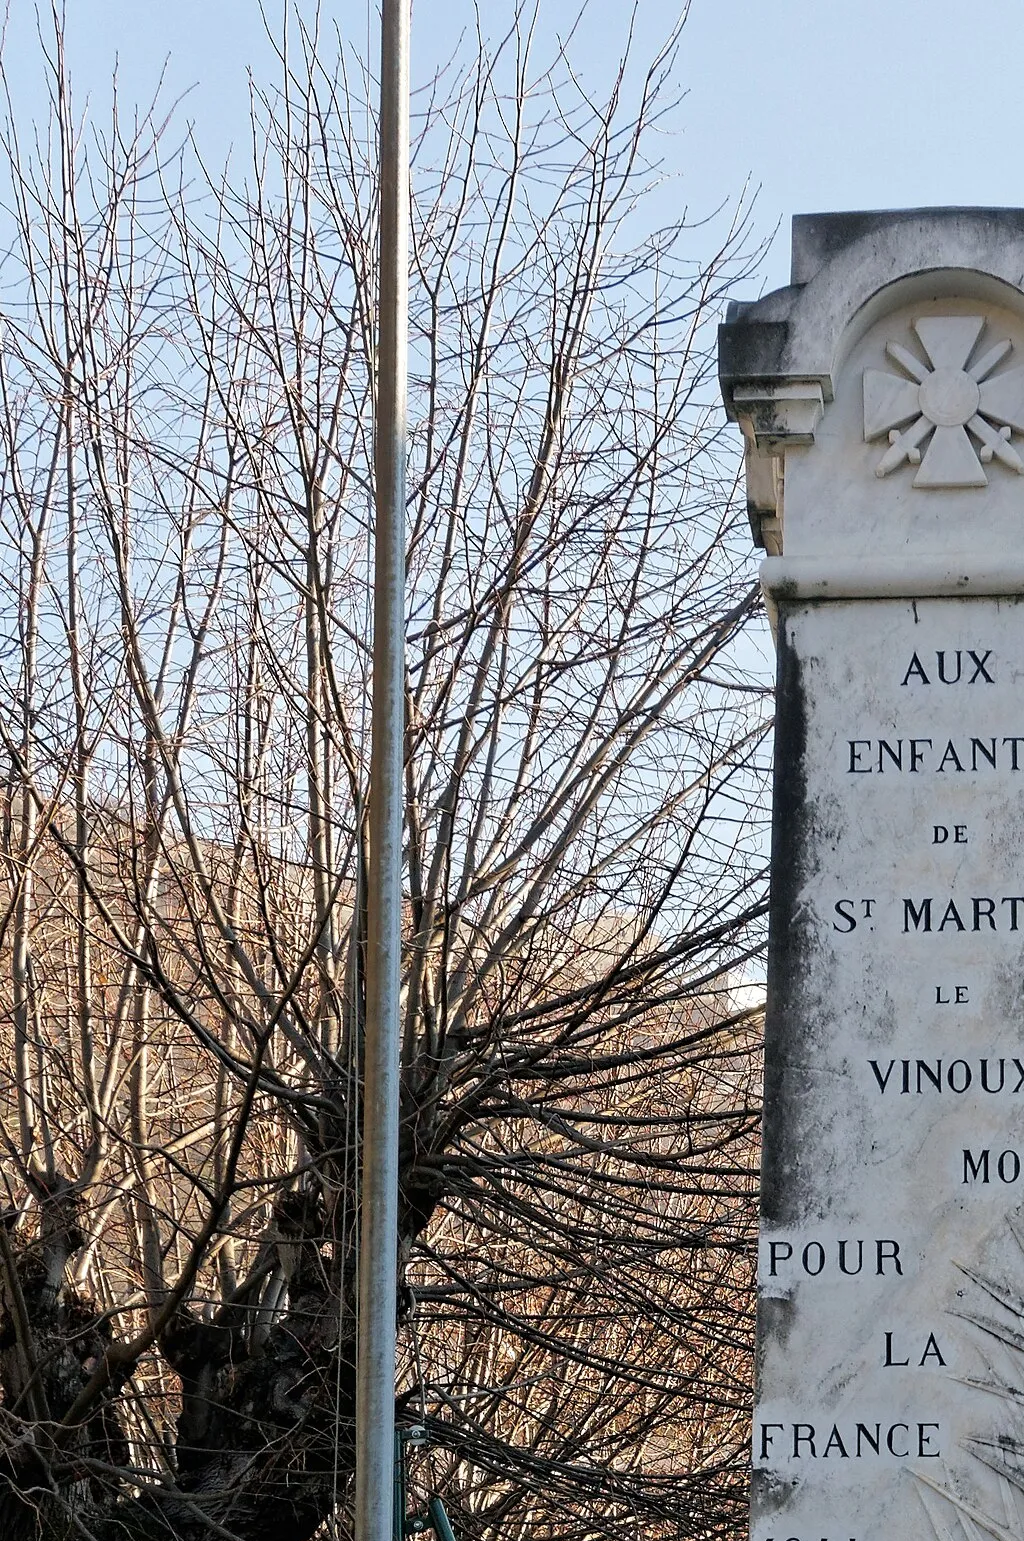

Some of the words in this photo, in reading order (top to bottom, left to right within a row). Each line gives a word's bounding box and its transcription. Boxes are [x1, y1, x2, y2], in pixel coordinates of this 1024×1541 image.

[901, 650, 995, 686] AUX
[932, 825, 968, 844] DE
[935, 986, 969, 1004] LE
[768, 1240, 904, 1277] POUR
[883, 1332, 947, 1367] LA
[759, 1422, 941, 1459] FRANCE
